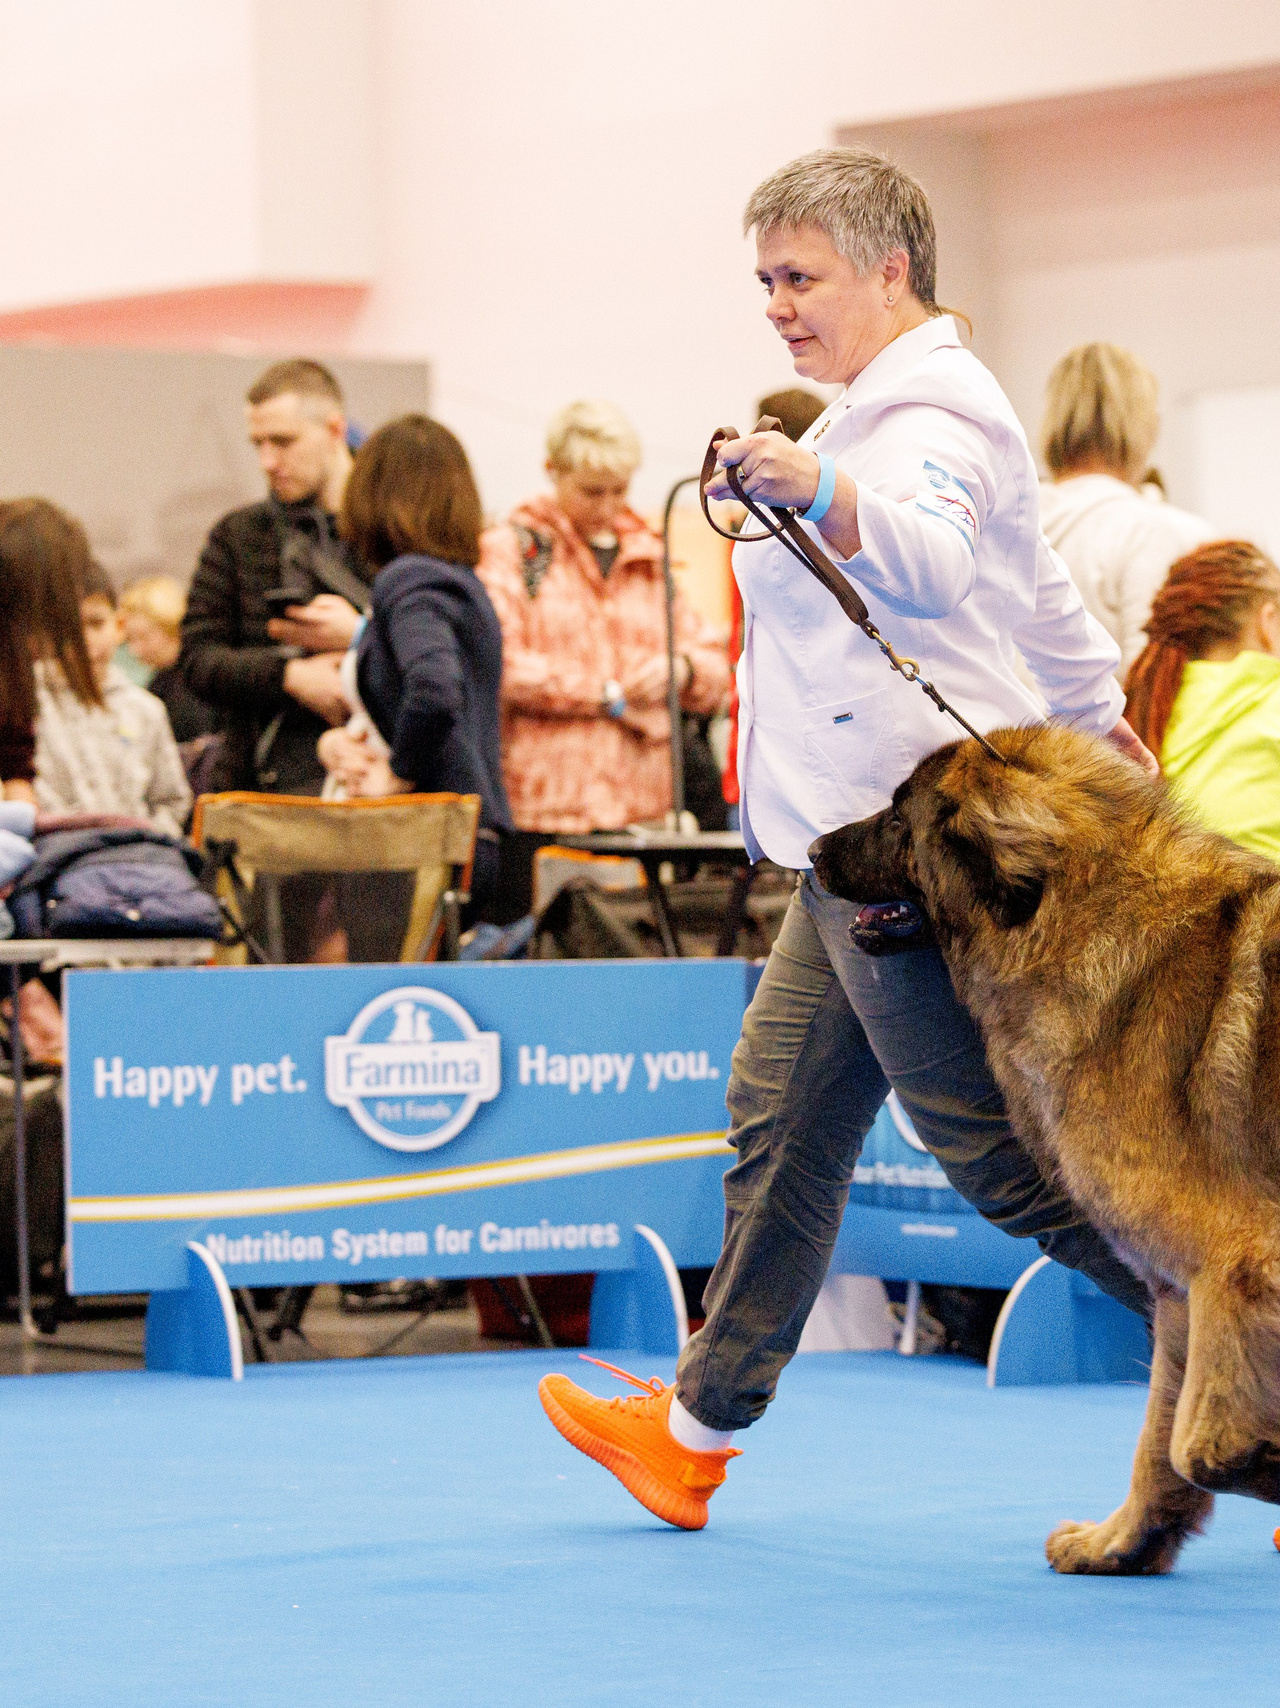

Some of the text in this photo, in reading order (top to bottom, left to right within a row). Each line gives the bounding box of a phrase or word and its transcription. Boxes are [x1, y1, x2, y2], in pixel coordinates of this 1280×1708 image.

[94, 1055, 307, 1108] Happy pet.
[345, 1051, 481, 1088] Farmina
[518, 1045, 719, 1094] Happy you.
[206, 1219, 620, 1265] Nutrition System for Carnivores
